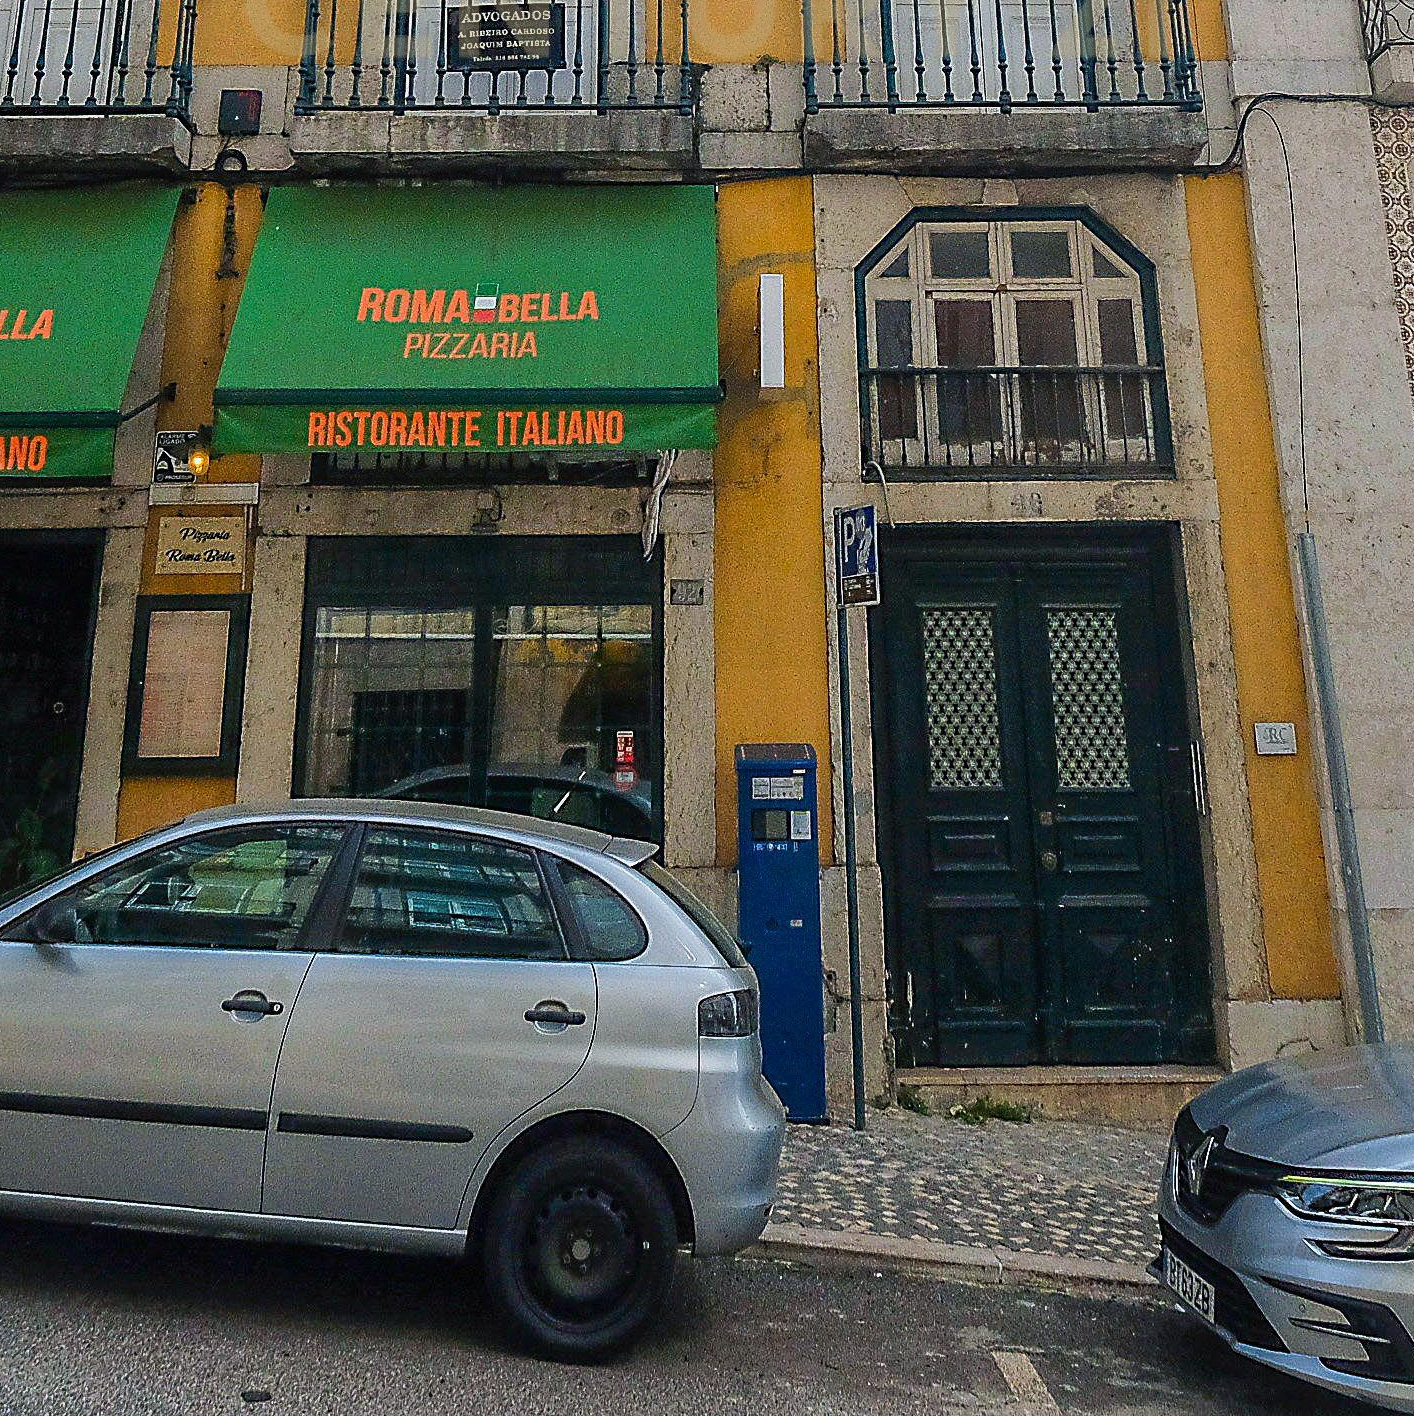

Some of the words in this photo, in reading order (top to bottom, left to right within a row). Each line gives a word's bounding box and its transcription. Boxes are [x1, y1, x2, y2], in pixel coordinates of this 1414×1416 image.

[462, 10, 551, 23] ADVOGADOS
[470, 29, 508, 38] RIBEIRO
[511, 27, 555, 36] CARDOSO
[461, 41, 503, 50] JOAQUIM
[506, 40, 551, 48] BAPTISTA
[357, 287, 470, 323] ROMA
[498, 290, 600, 322] BELLA
[403, 331, 537, 359] PIZZARIA
[307, 411, 482, 447] RISTORANTE
[497, 409, 625, 446] ITALIANO
[165, 548, 201, 562] Roma
[203, 548, 236, 562] Bella
